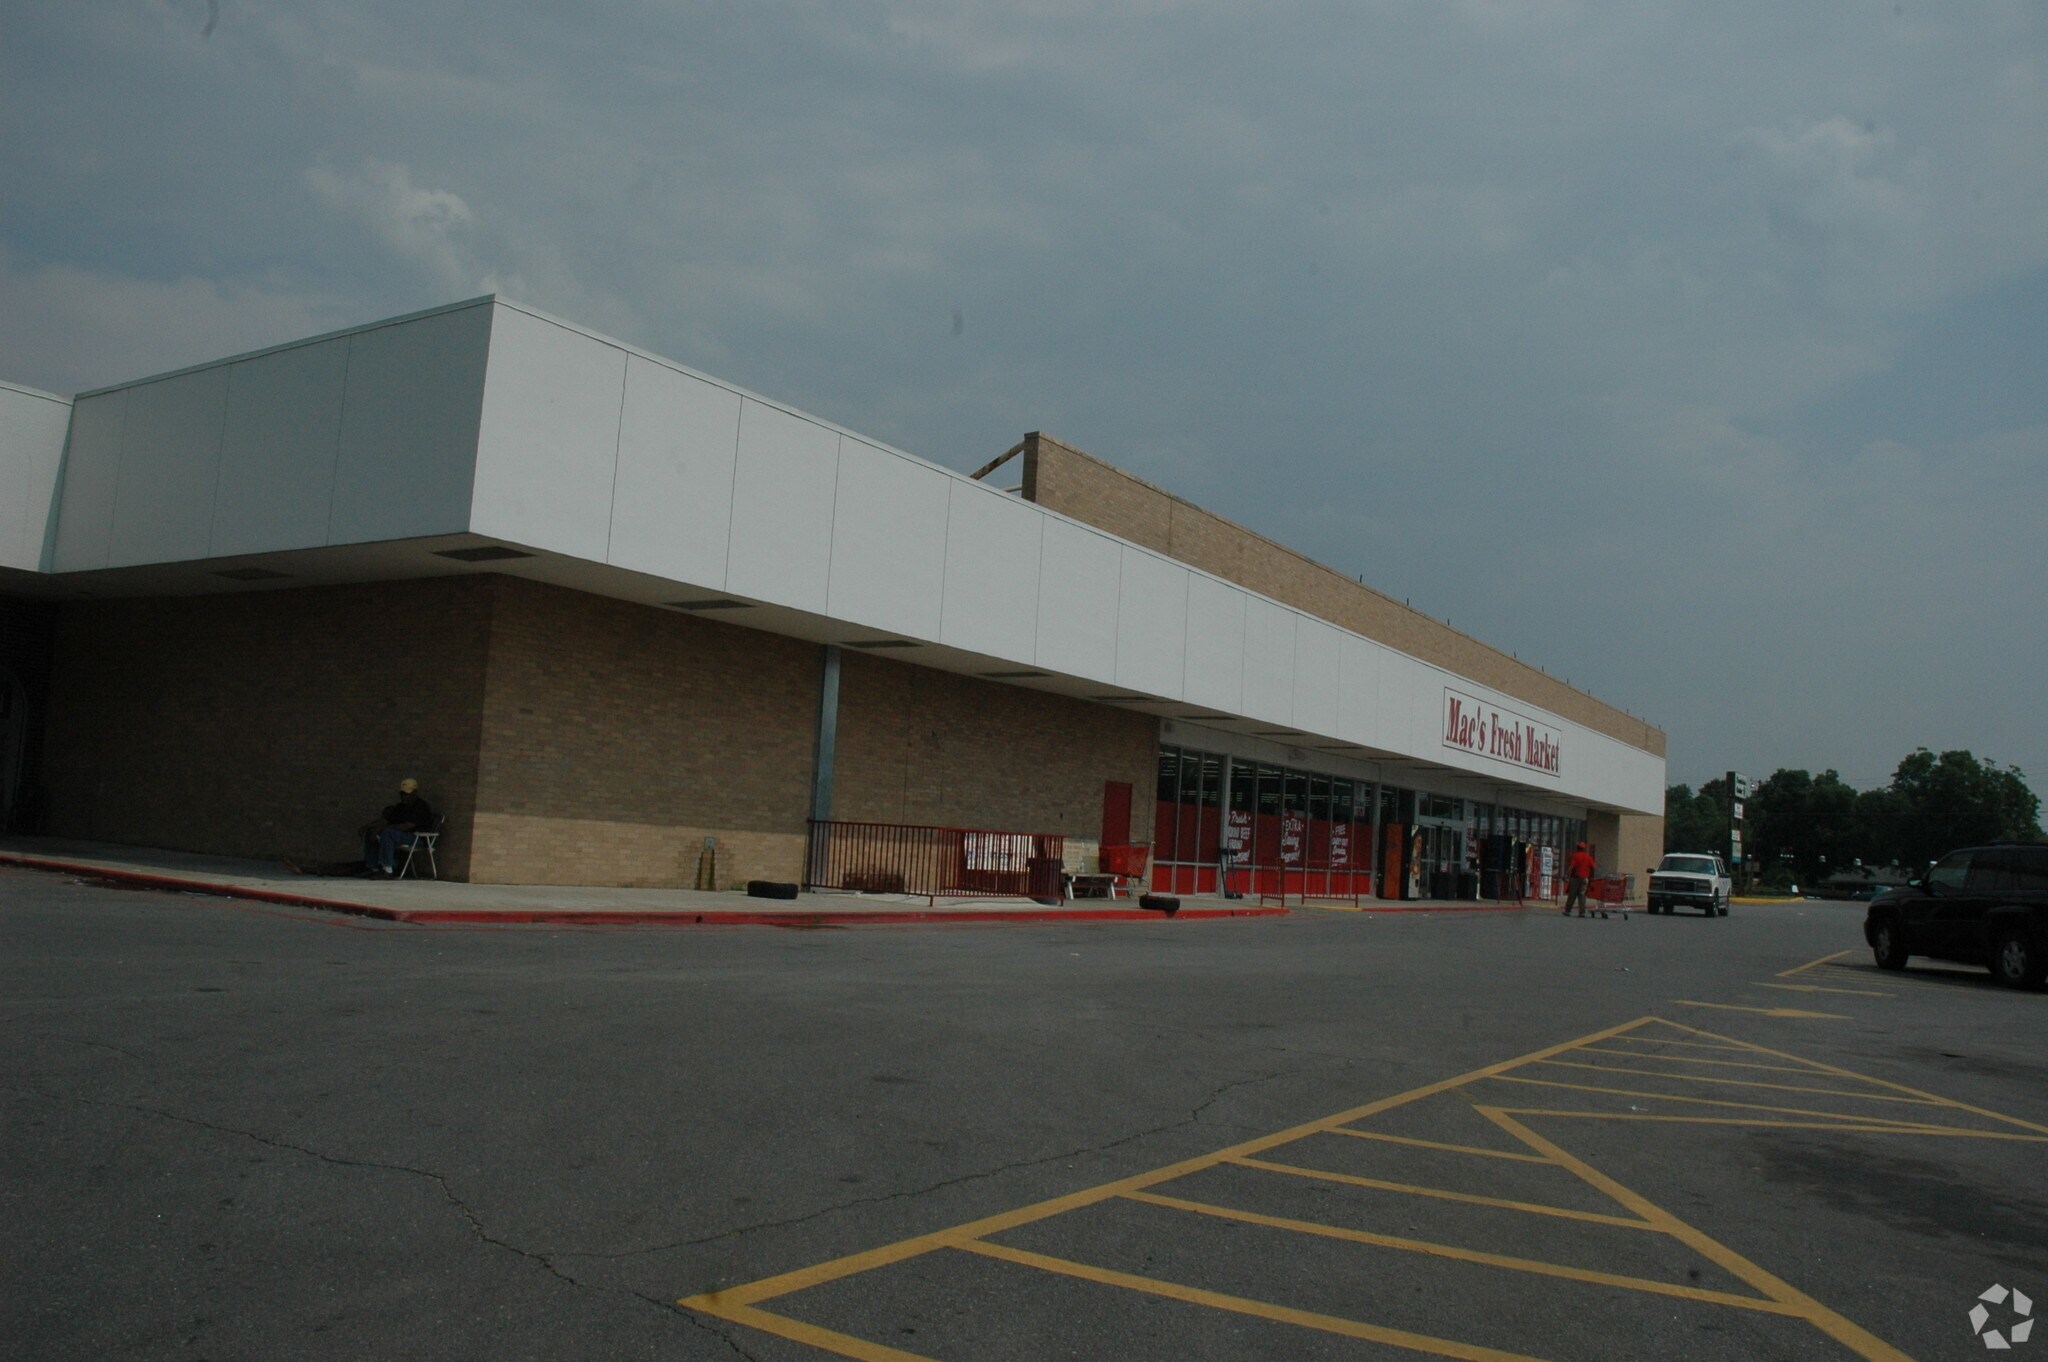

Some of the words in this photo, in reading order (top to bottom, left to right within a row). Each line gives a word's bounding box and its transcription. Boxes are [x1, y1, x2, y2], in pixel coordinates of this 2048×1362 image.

[1446, 697, 1486, 751] Mac's
[1490, 712, 1521, 762] Fresh
[1525, 725, 1559, 773] Market
